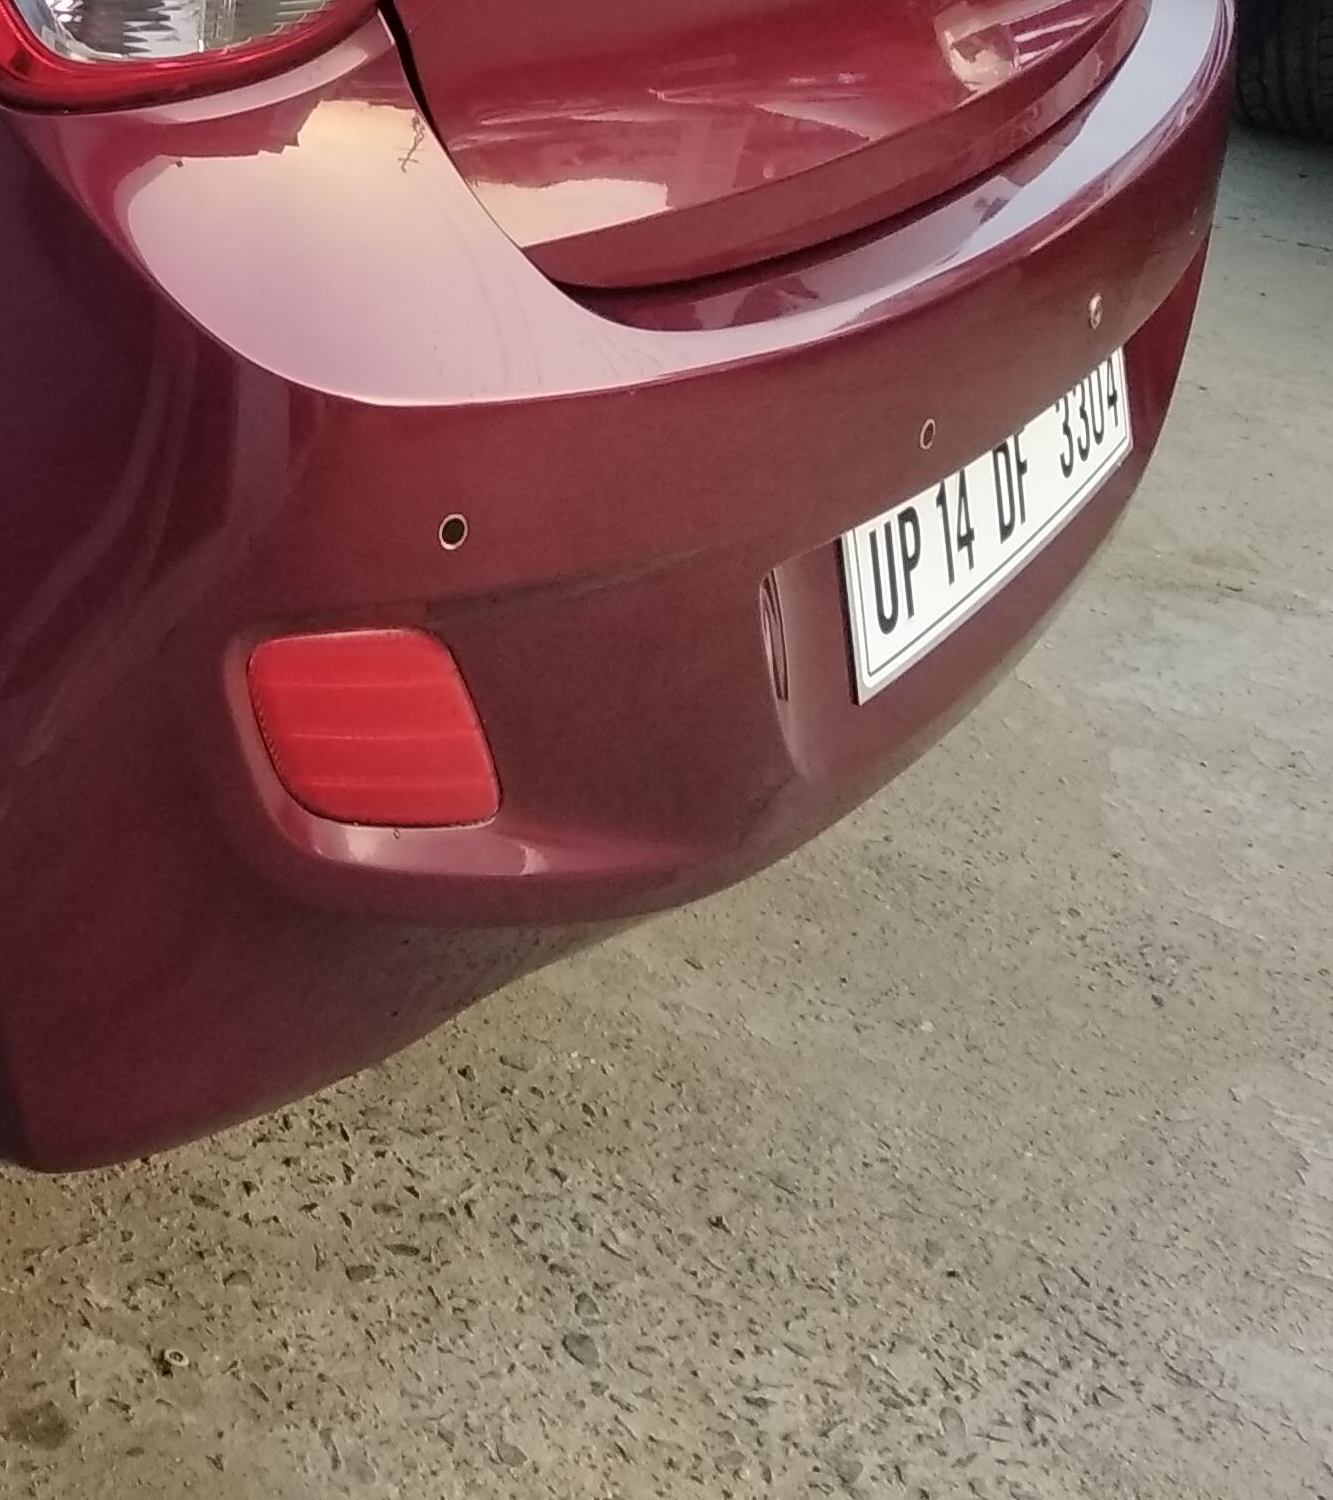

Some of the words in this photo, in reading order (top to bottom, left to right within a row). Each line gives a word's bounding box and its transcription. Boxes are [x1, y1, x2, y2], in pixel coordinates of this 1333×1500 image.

[869, 505, 921, 635] UP
[935, 469, 975, 585] 14
[991, 434, 1028, 545] DF
[1054, 357, 1119, 479] 3304
